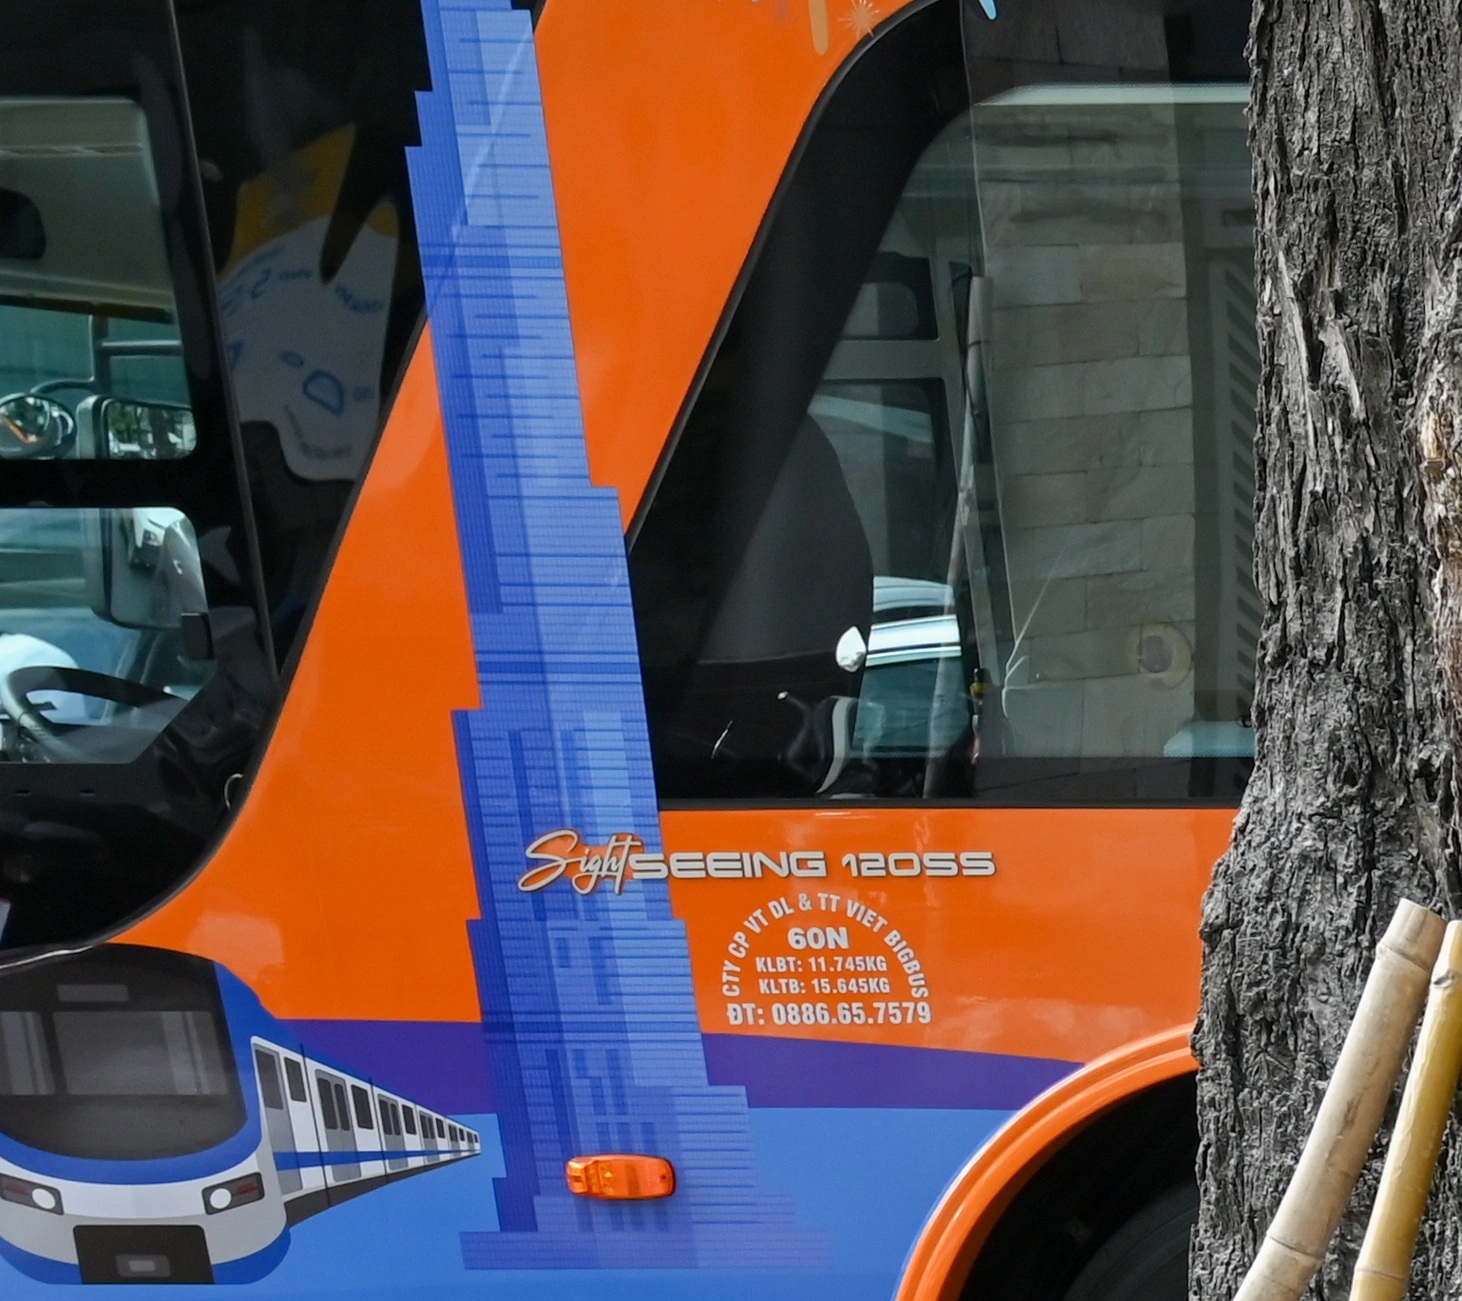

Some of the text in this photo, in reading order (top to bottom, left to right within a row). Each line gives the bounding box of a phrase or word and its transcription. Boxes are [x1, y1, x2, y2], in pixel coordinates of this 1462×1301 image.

[722, 892, 929, 999] CTY CP VT DL & TT VIET BIGBUS
[755, 955, 888, 973] KLBT: 11.745KG
[759, 977, 891, 995] KLTB: 15.645KG
[727, 1001, 932, 1025] ĐT: 0886.65.7579
